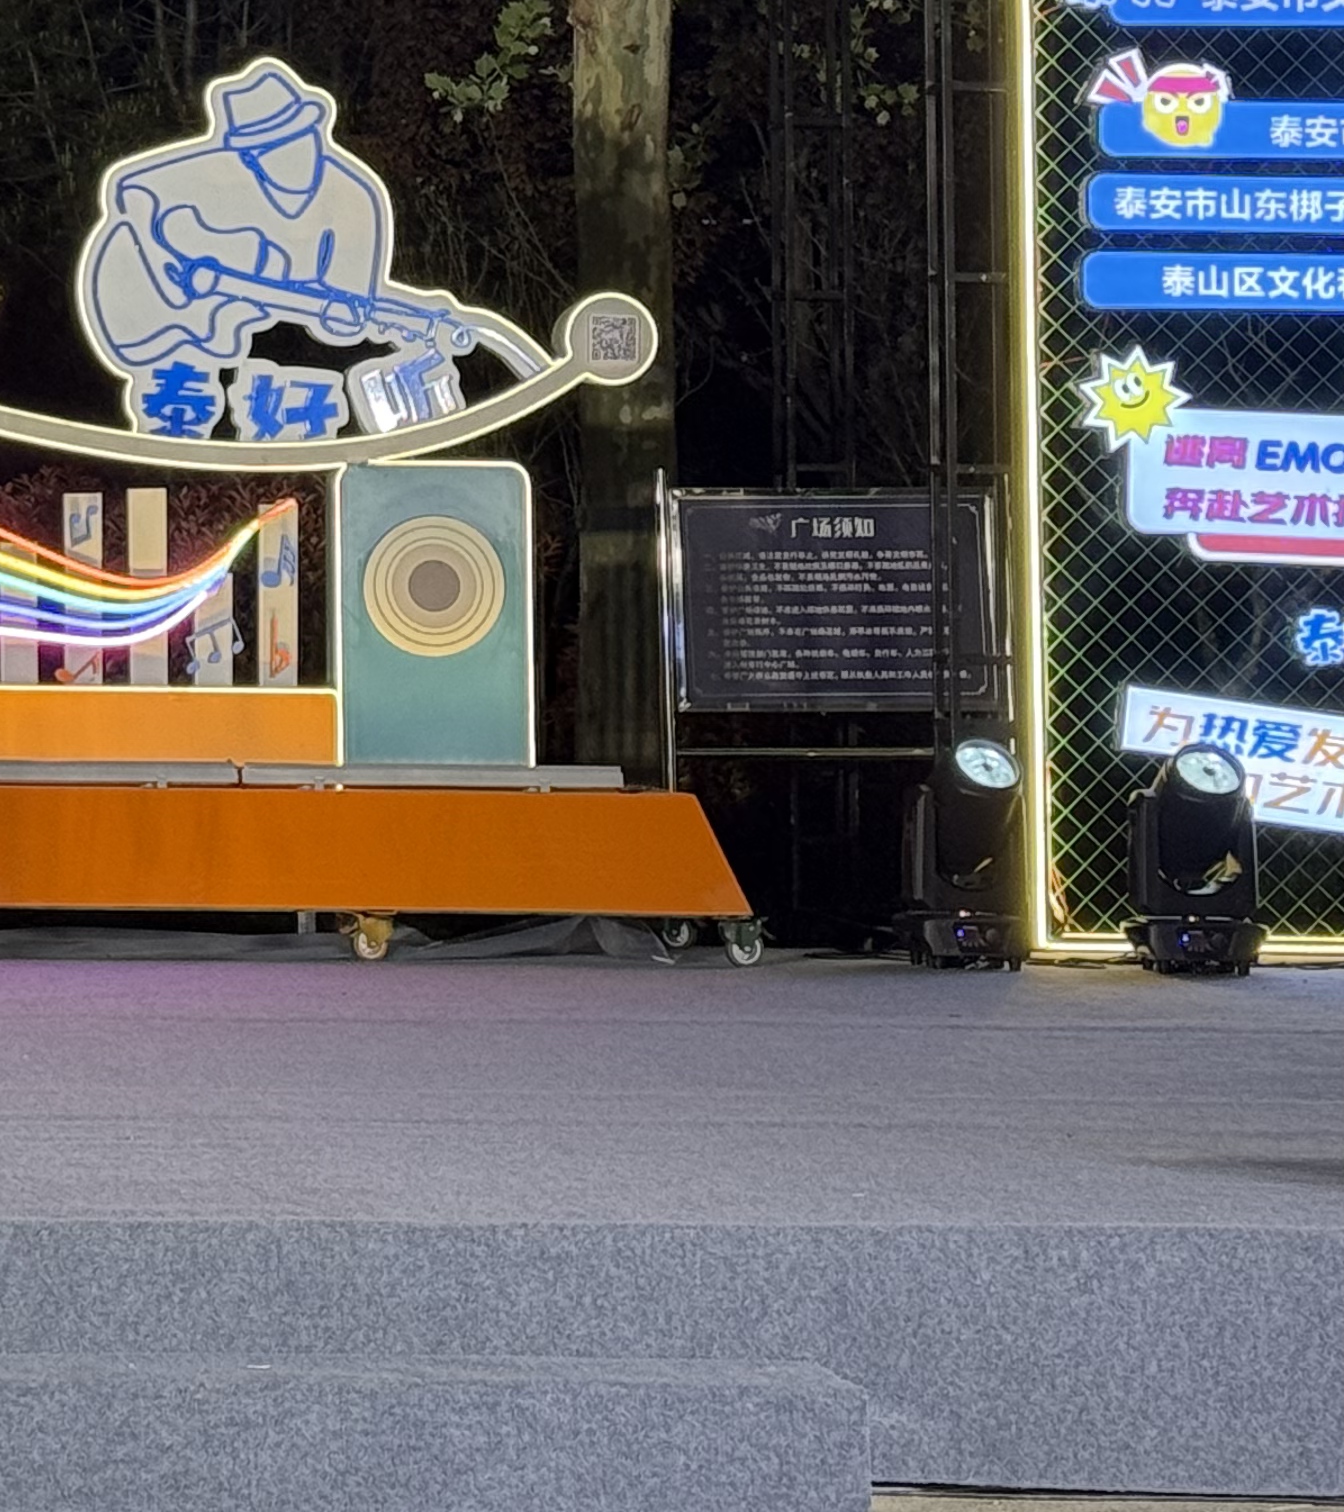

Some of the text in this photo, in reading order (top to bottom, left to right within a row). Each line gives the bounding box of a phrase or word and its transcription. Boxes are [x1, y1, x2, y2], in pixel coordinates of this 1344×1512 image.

[1270, 115, 1344, 148] 泰安
[1161, 265, 1344, 300] 泰山区文化
[1163, 487, 1344, 528] 奔赴艺术
[790, 516, 875, 539] 广场须知
